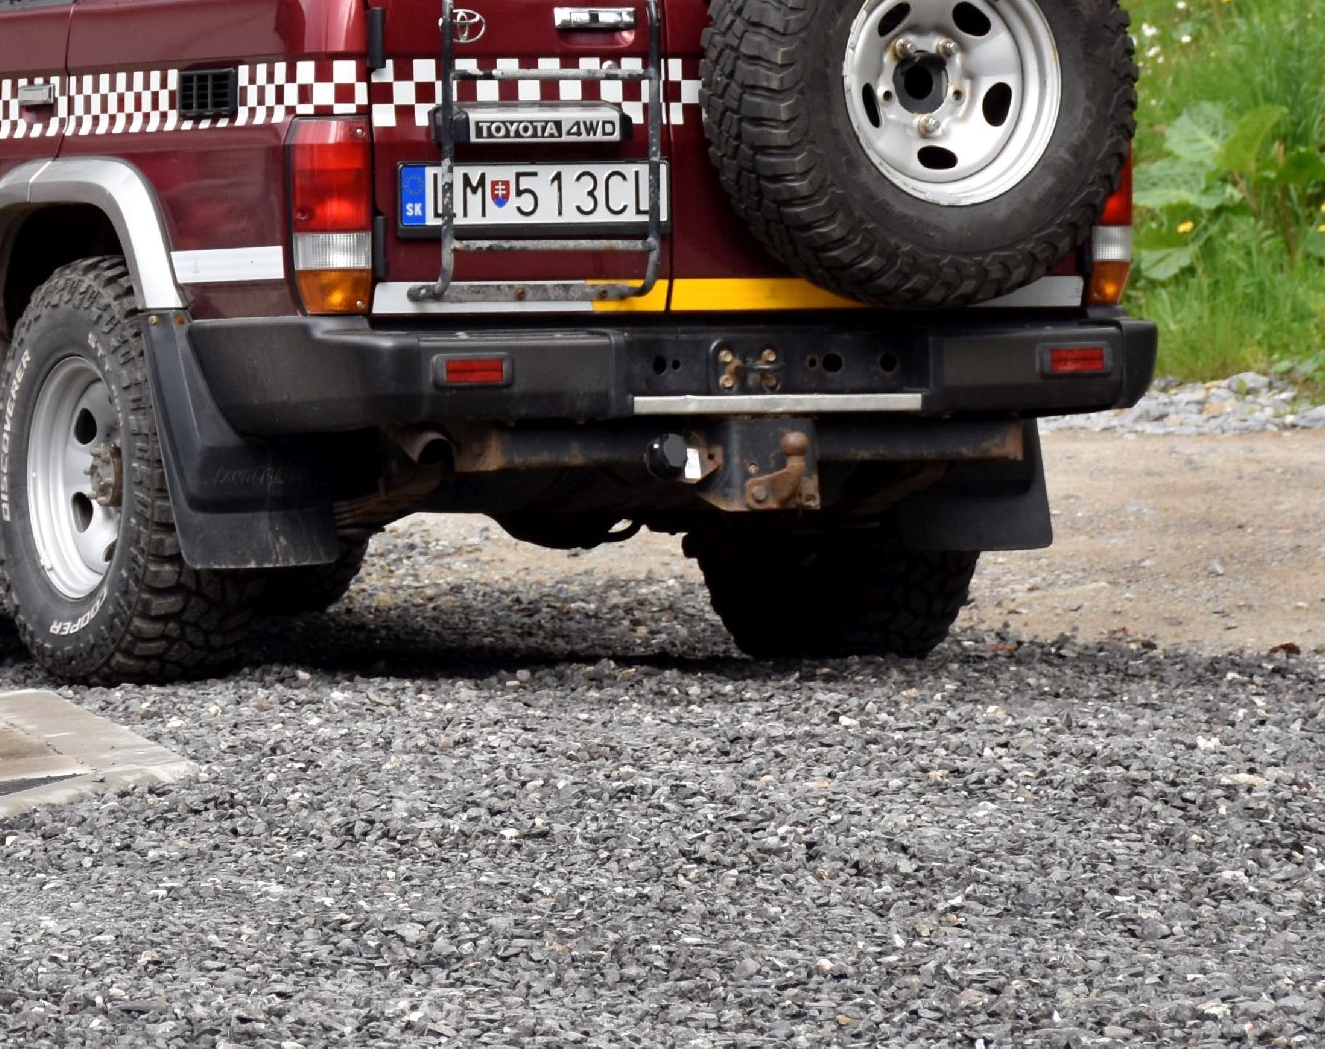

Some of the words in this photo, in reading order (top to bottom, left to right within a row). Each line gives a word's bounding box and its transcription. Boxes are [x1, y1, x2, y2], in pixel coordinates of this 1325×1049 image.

[478, 121, 559, 138] TOYOTA
[565, 119, 617, 138] 4WD
[405, 202, 423, 217] SK
[0, 348, 32, 522] DISCOVERER
[49, 584, 108, 636] COOPER
